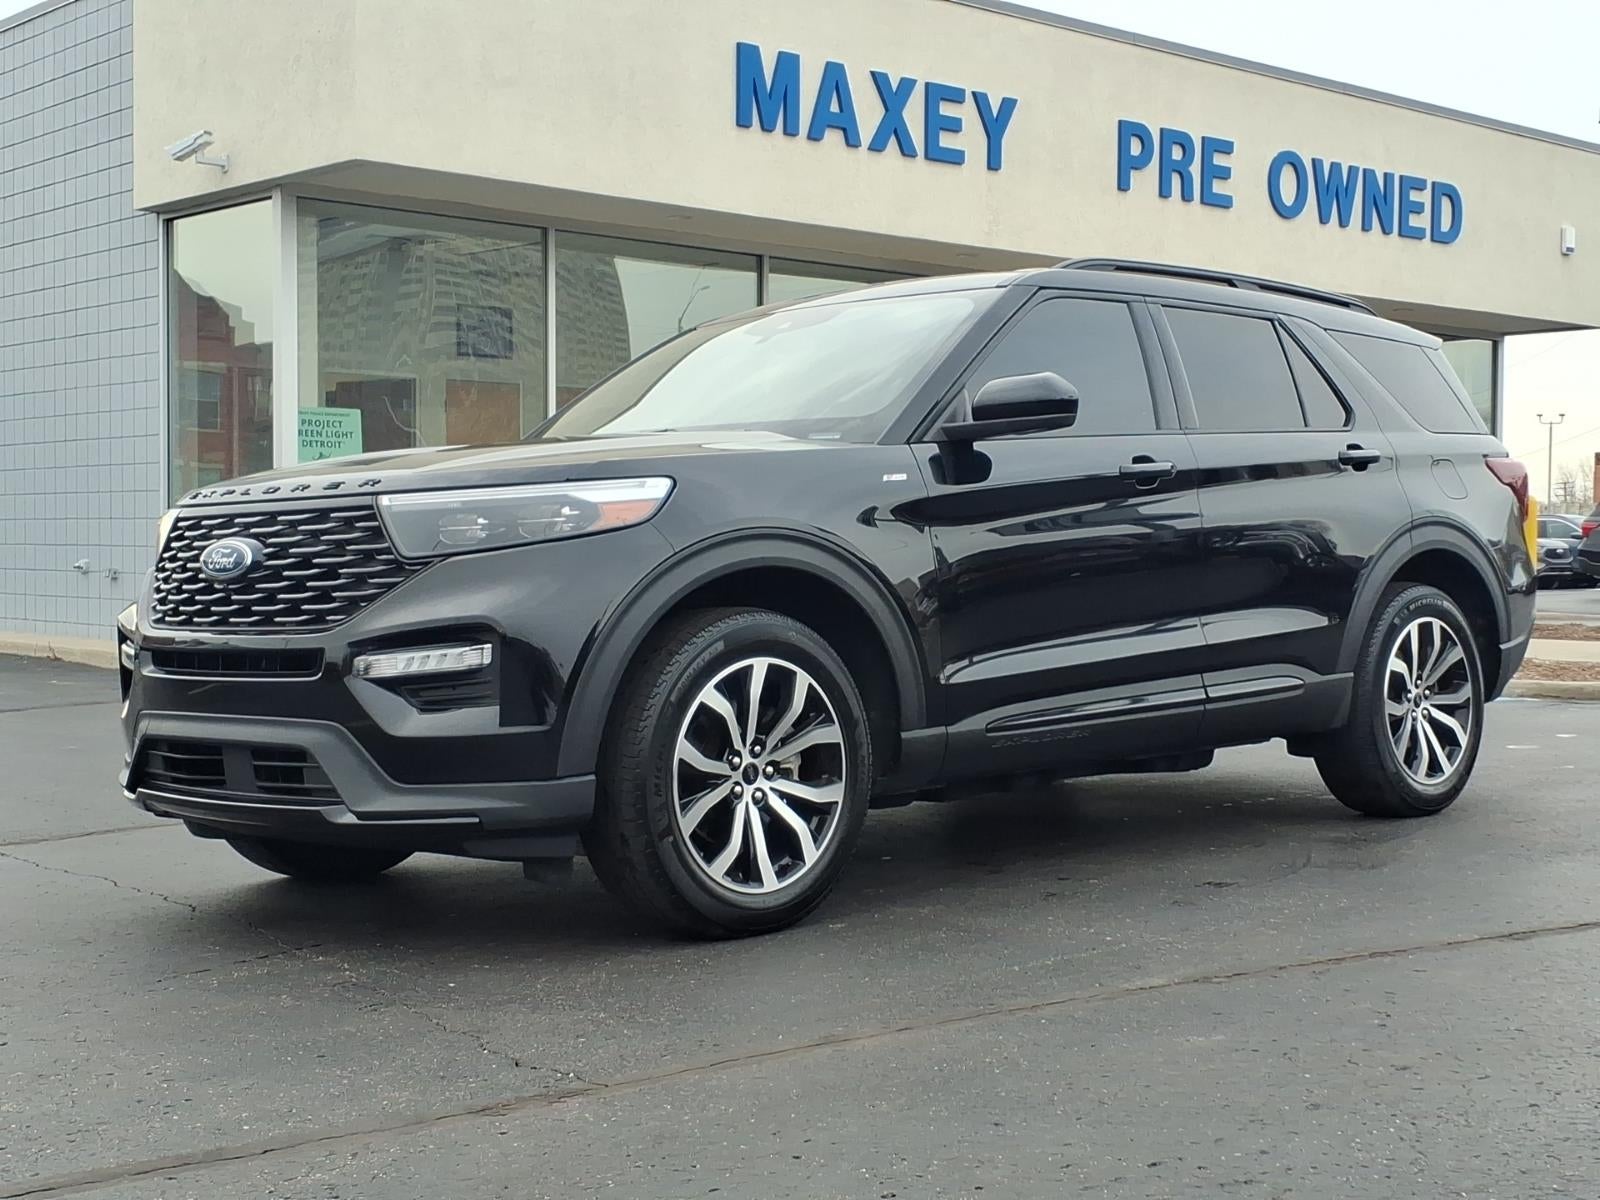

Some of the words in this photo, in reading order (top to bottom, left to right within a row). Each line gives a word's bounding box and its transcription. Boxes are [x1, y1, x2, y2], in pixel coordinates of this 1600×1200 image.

[735, 41, 1018, 171] MAXEY
[1117, 119, 1235, 208] PRE
[1267, 150, 1463, 244] OWNED
[301, 418, 343, 430] PROJECT
[298, 429, 322, 438] REEN
[325, 430, 354, 439] LIGHT
[302, 439, 342, 449] DETROIT
[189, 479, 382, 499] EXPLORER
[208, 547, 238, 569] Ford
